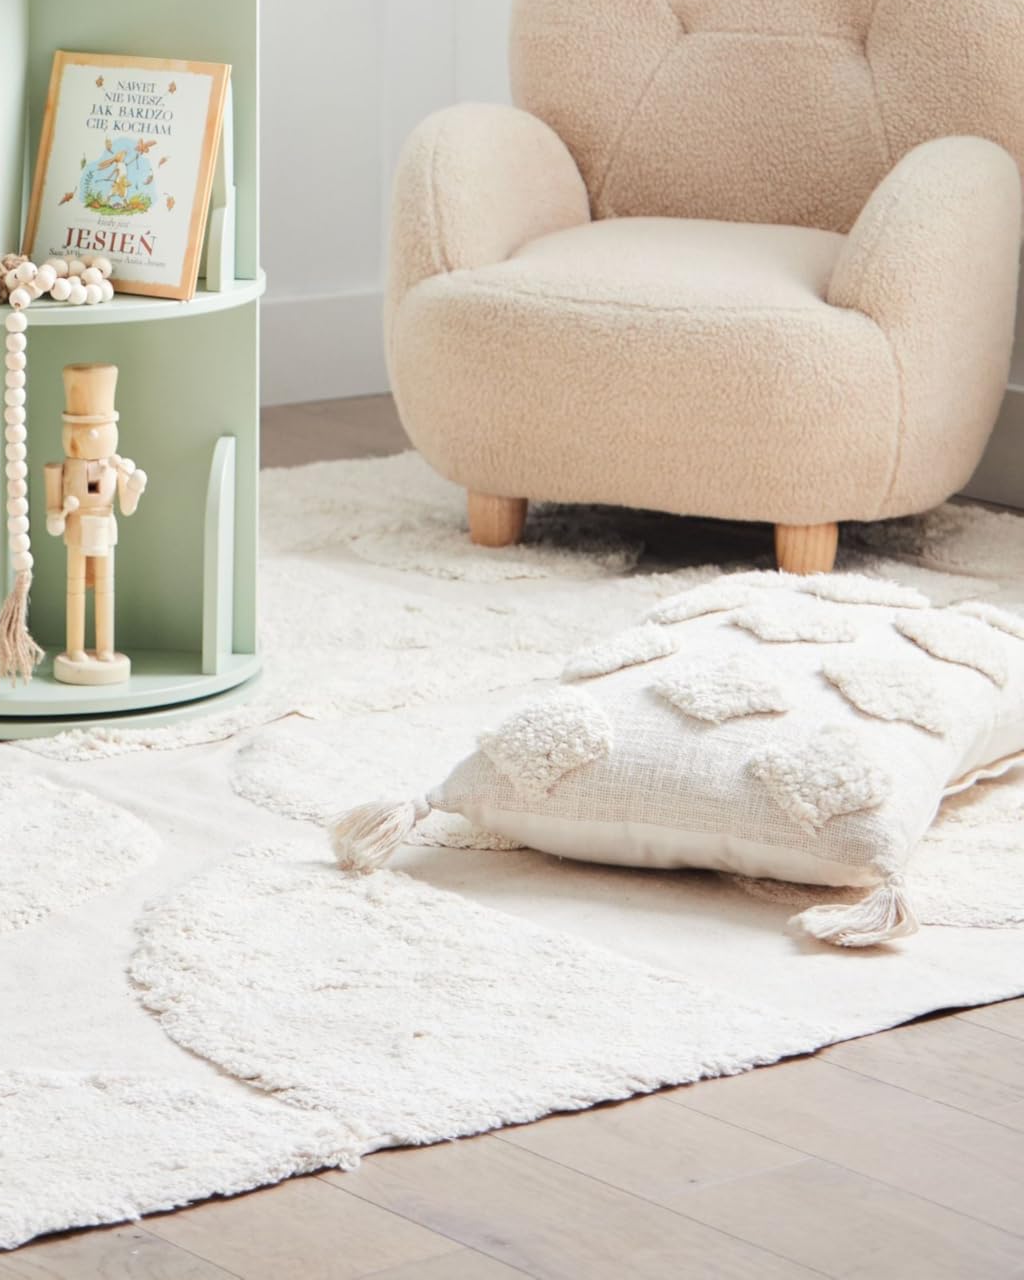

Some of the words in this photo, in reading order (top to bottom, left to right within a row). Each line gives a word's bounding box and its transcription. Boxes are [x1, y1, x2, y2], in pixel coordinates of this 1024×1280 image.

[117, 80, 156, 93] NAWET
[104, 92, 124, 103] NIE
[127, 94, 165, 107] WIESZ,
[90, 104, 112, 116] JAK
[119, 106, 173, 121] BARDZO
[86, 118, 108, 132] CIĘ
[113, 120, 173, 136] KOCHAM
[62, 227, 158, 255] JESIEŃ
